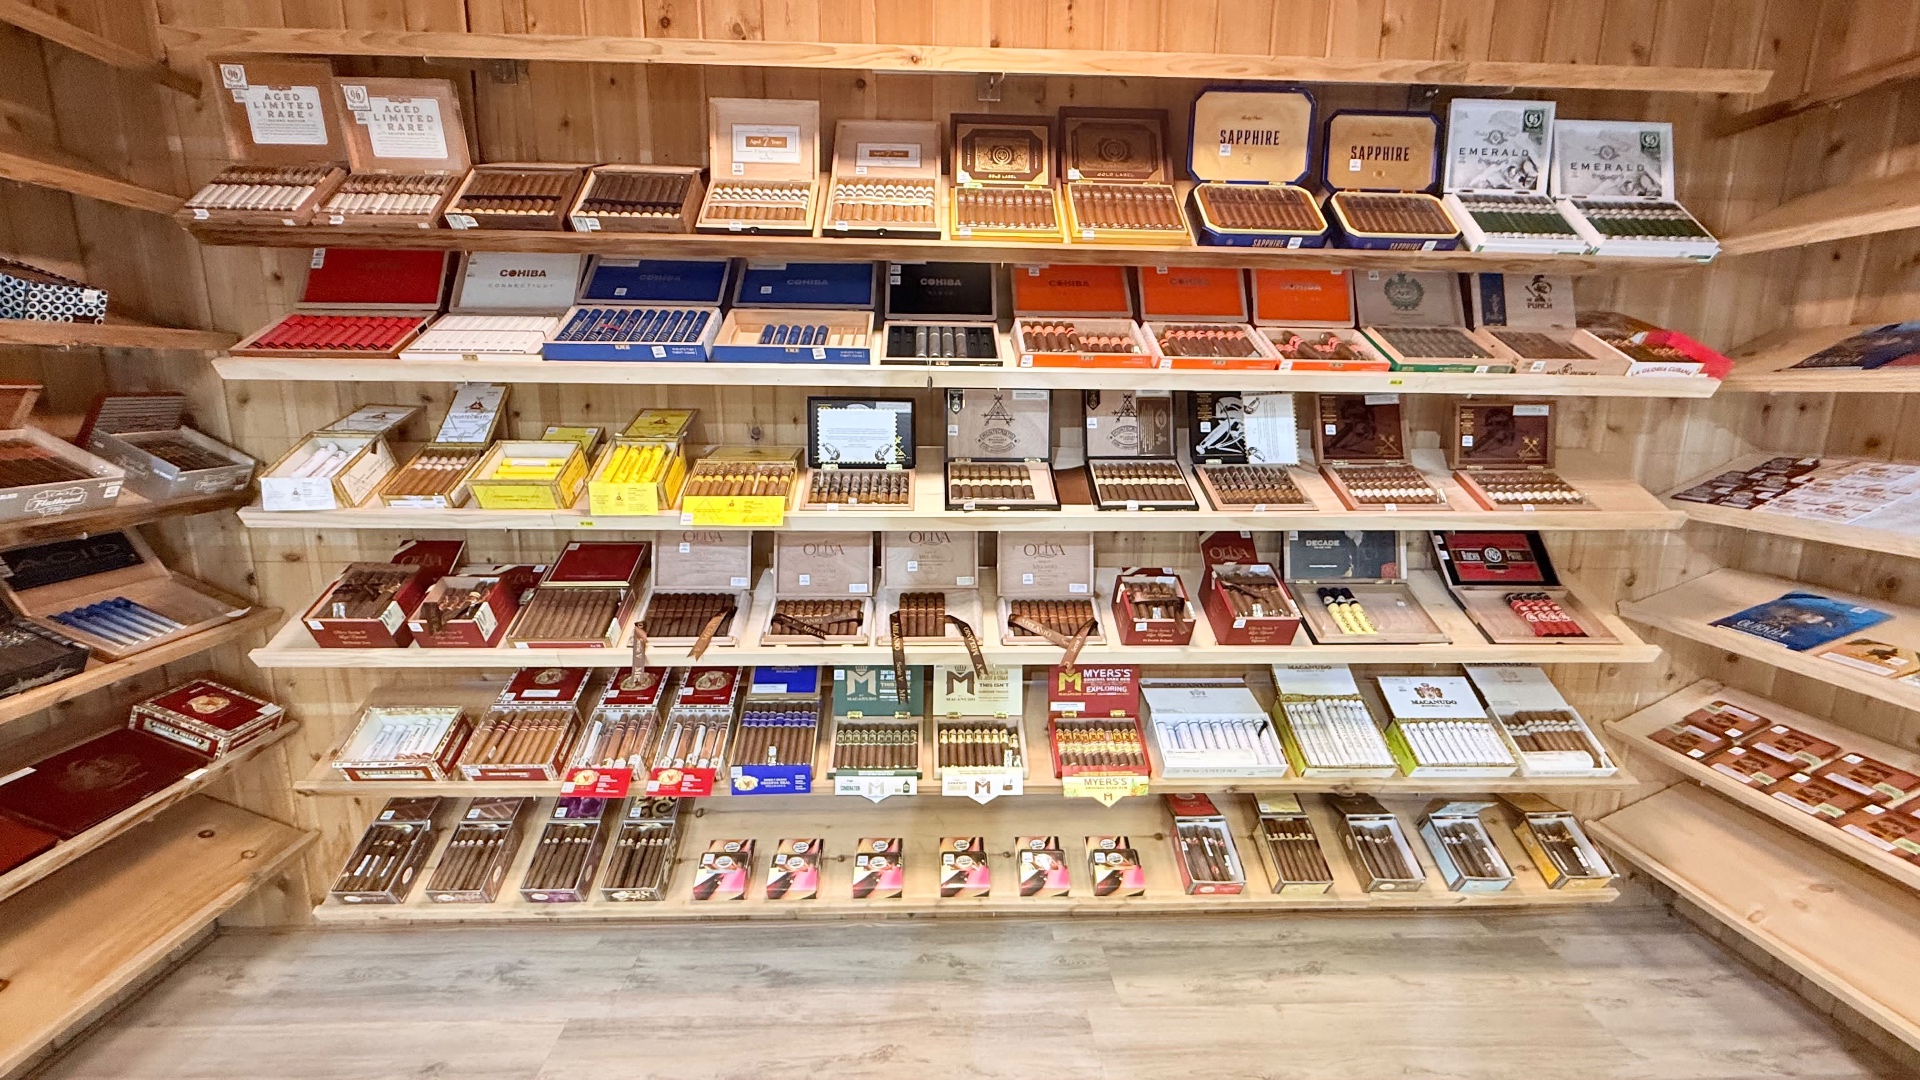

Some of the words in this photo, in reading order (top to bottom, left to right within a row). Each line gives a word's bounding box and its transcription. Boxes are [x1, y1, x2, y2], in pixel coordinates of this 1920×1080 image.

[264, 92, 300, 101] AGED
[253, 101, 314, 110] LIMITED
[384, 105, 420, 113] AGED
[267, 110, 305, 118] RARE
[373, 113, 434, 123] LIMITED
[387, 123, 425, 131] RARE
[1219, 129, 1280, 146] SAPPHIRE
[1350, 145, 1410, 162] SAPPHIRE
[1459, 147, 1529, 157] EMERALD
[1570, 162, 1645, 172] EMERALD
[1252, 239, 1286, 248] SAPPHIRE
[1389, 242, 1422, 251] SAPPHIRE
[499, 269, 547, 278] COHIBA
[920, 278, 962, 286] COHIBA
[1048, 279, 1090, 287] COHIBA
[1668, 366, 1692, 376] CUBANA
[682, 530, 723, 544] OLIVA
[909, 531, 951, 545] OLIVA
[803, 541, 845, 557] OLIVA
[1024, 541, 1066, 557] OLIVA
[1209, 545, 1251, 560] OLIVA
[1021, 618, 1052, 637] MELANIO
[892, 622, 901, 651] MELANIO
[963, 626, 980, 656] MELANIO
[1083, 668, 1131, 678] MYERS'S
[1086, 685, 1128, 693] EXPLORING
[1083, 777, 1128, 787] MYERS'S
[975, 780, 991, 795] M
[1104, 792, 1113, 801] M
